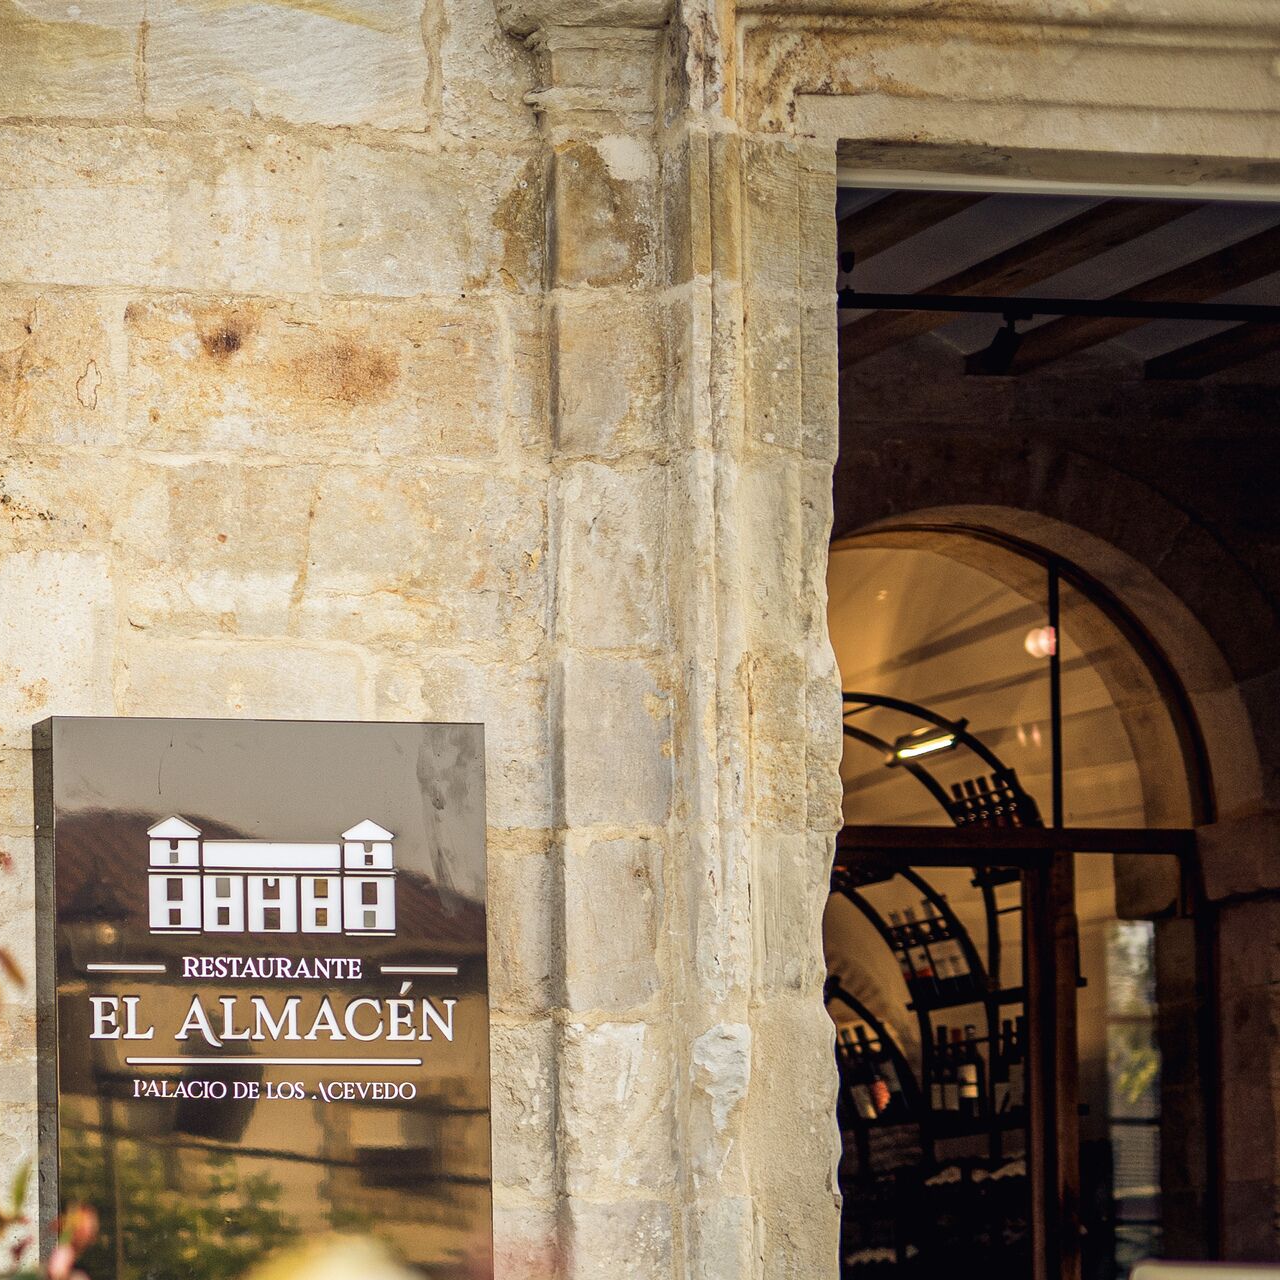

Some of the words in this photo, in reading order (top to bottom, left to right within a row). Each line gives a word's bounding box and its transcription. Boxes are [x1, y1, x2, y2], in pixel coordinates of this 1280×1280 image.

[182, 956, 363, 980] RESTAURANTE
[89, 996, 154, 1040] EL
[174, 981, 458, 1048] ALMACÉN
[133, 1079, 227, 1100] PALACIO
[233, 1081, 260, 1100] DE
[265, 1081, 305, 1100] LOS
[311, 1080, 417, 1103] ACEVEDO
